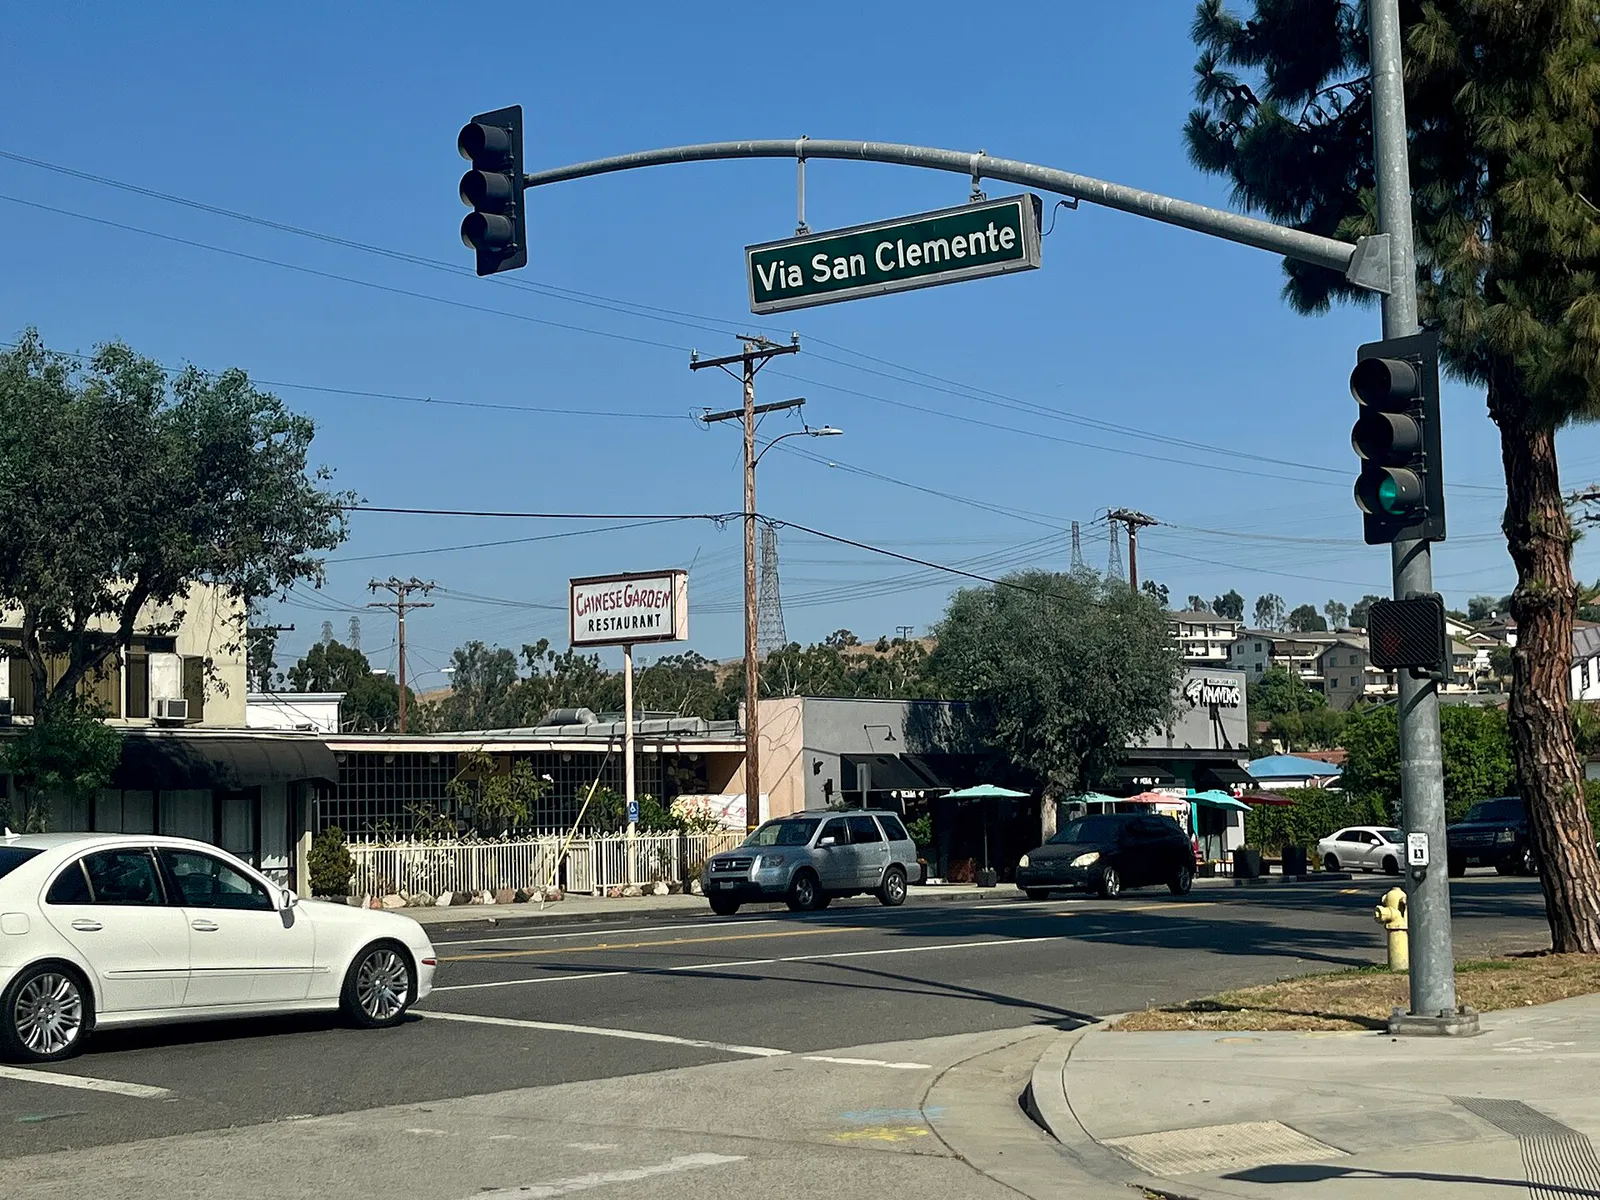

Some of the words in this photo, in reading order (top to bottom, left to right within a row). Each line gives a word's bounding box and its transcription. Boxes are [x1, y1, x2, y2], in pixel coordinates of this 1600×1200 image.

[756, 260, 804, 291] Via
[811, 253, 867, 283] San
[875, 221, 1016, 272] Clemente
[576, 590, 623, 617] CHINESE
[623, 584, 671, 609] GARDEN
[588, 614, 661, 632] RESTAURANT
